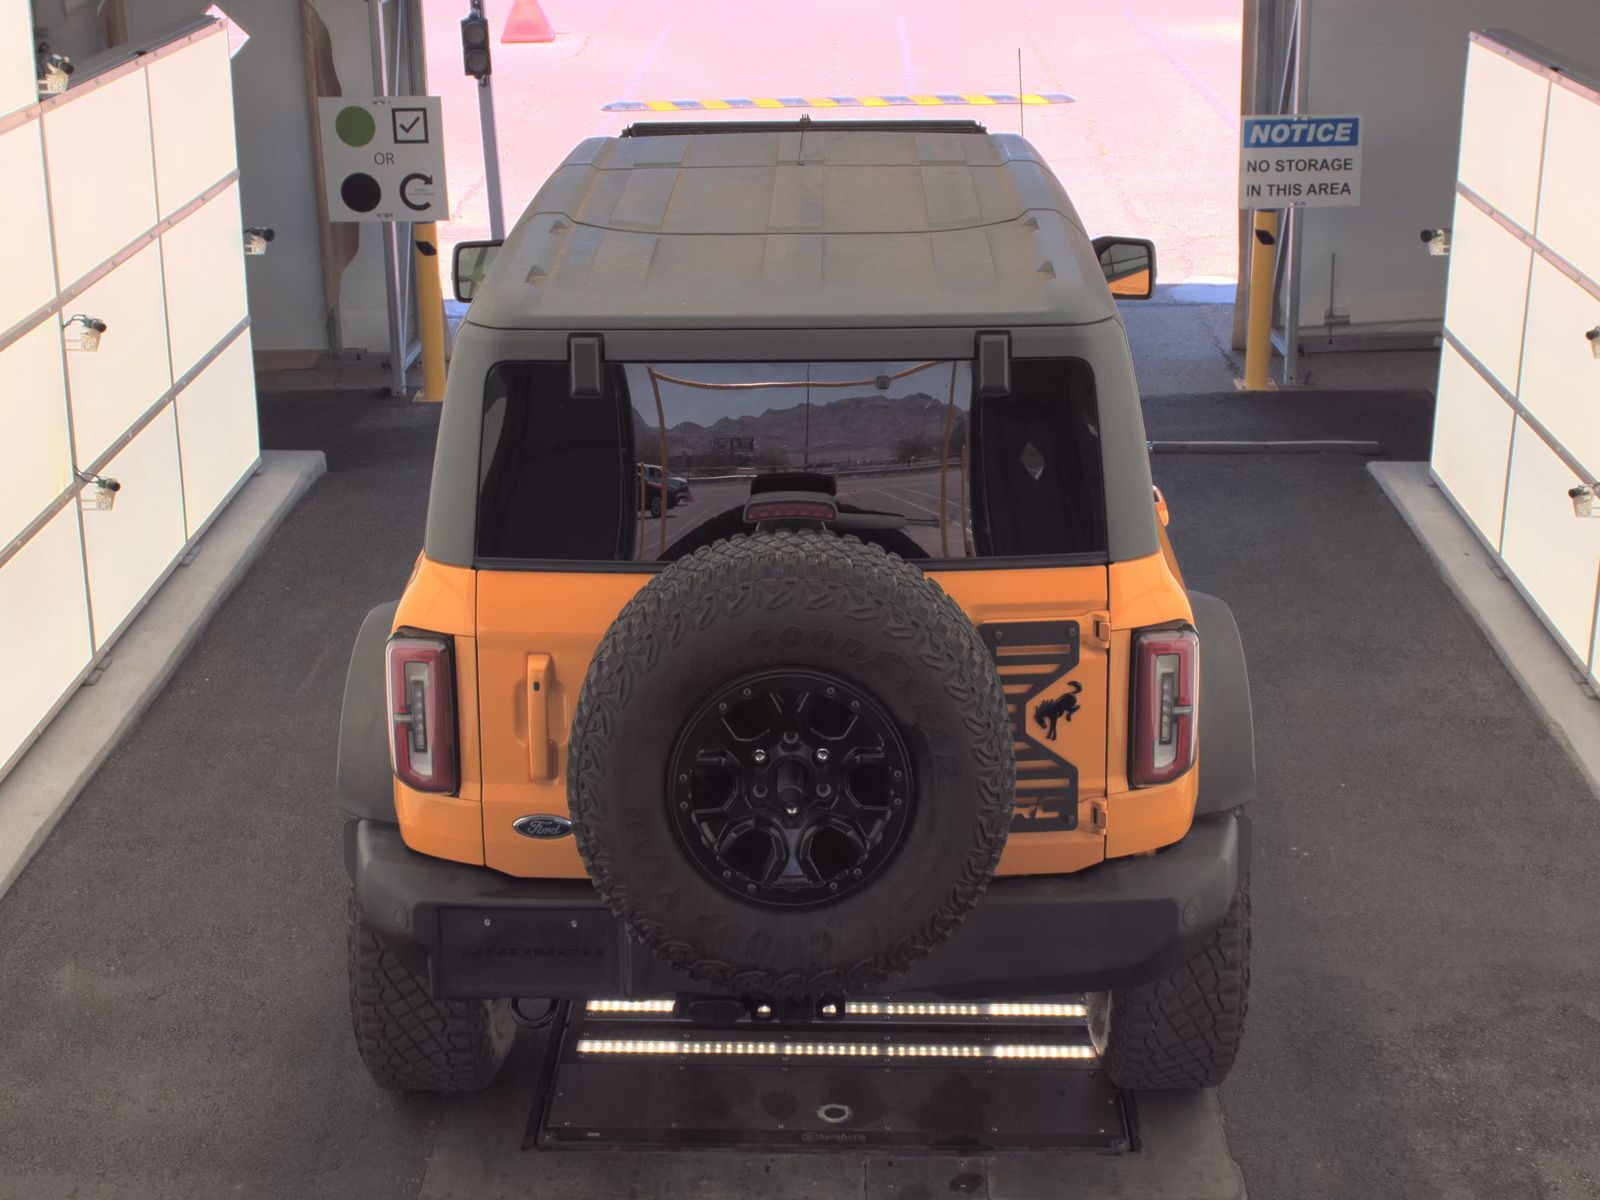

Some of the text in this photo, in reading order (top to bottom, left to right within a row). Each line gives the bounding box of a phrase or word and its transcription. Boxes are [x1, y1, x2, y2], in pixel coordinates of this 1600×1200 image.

[1249, 122, 1353, 144] NOTICE
[373, 152, 395, 166] OR
[1246, 158, 1354, 173] NO STORAGE
[1246, 182, 1351, 197] IN THIS AREA
[527, 820, 561, 836] Ford
